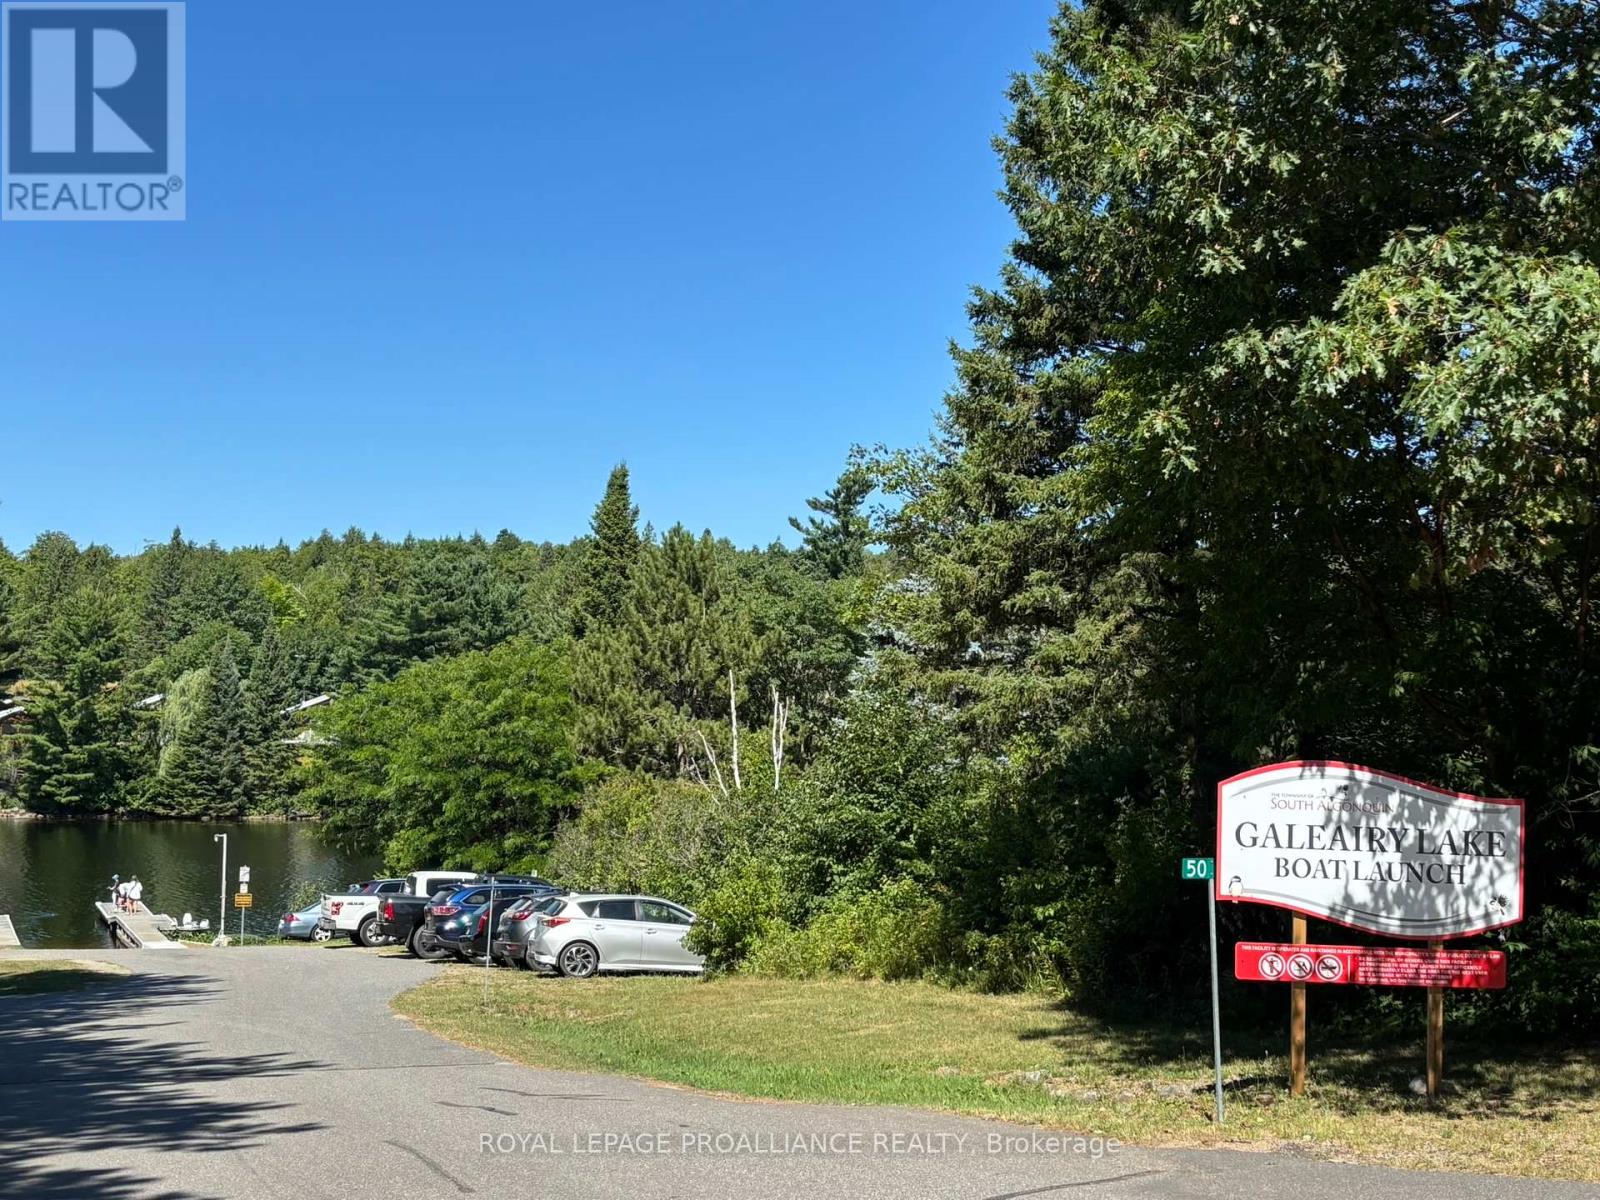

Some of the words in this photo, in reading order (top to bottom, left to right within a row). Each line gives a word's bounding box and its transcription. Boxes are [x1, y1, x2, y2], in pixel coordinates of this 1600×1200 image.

[1270, 797, 1314, 811] SOUTH
[1317, 799, 1394, 815] ALGONQUIN
[1235, 821, 1410, 855] GALEAIRY
[1417, 827, 1507, 858] LAKE
[1186, 859, 1207, 878] 50
[1274, 857, 1347, 881] BOAT
[1352, 860, 1466, 886] LAUNCH
